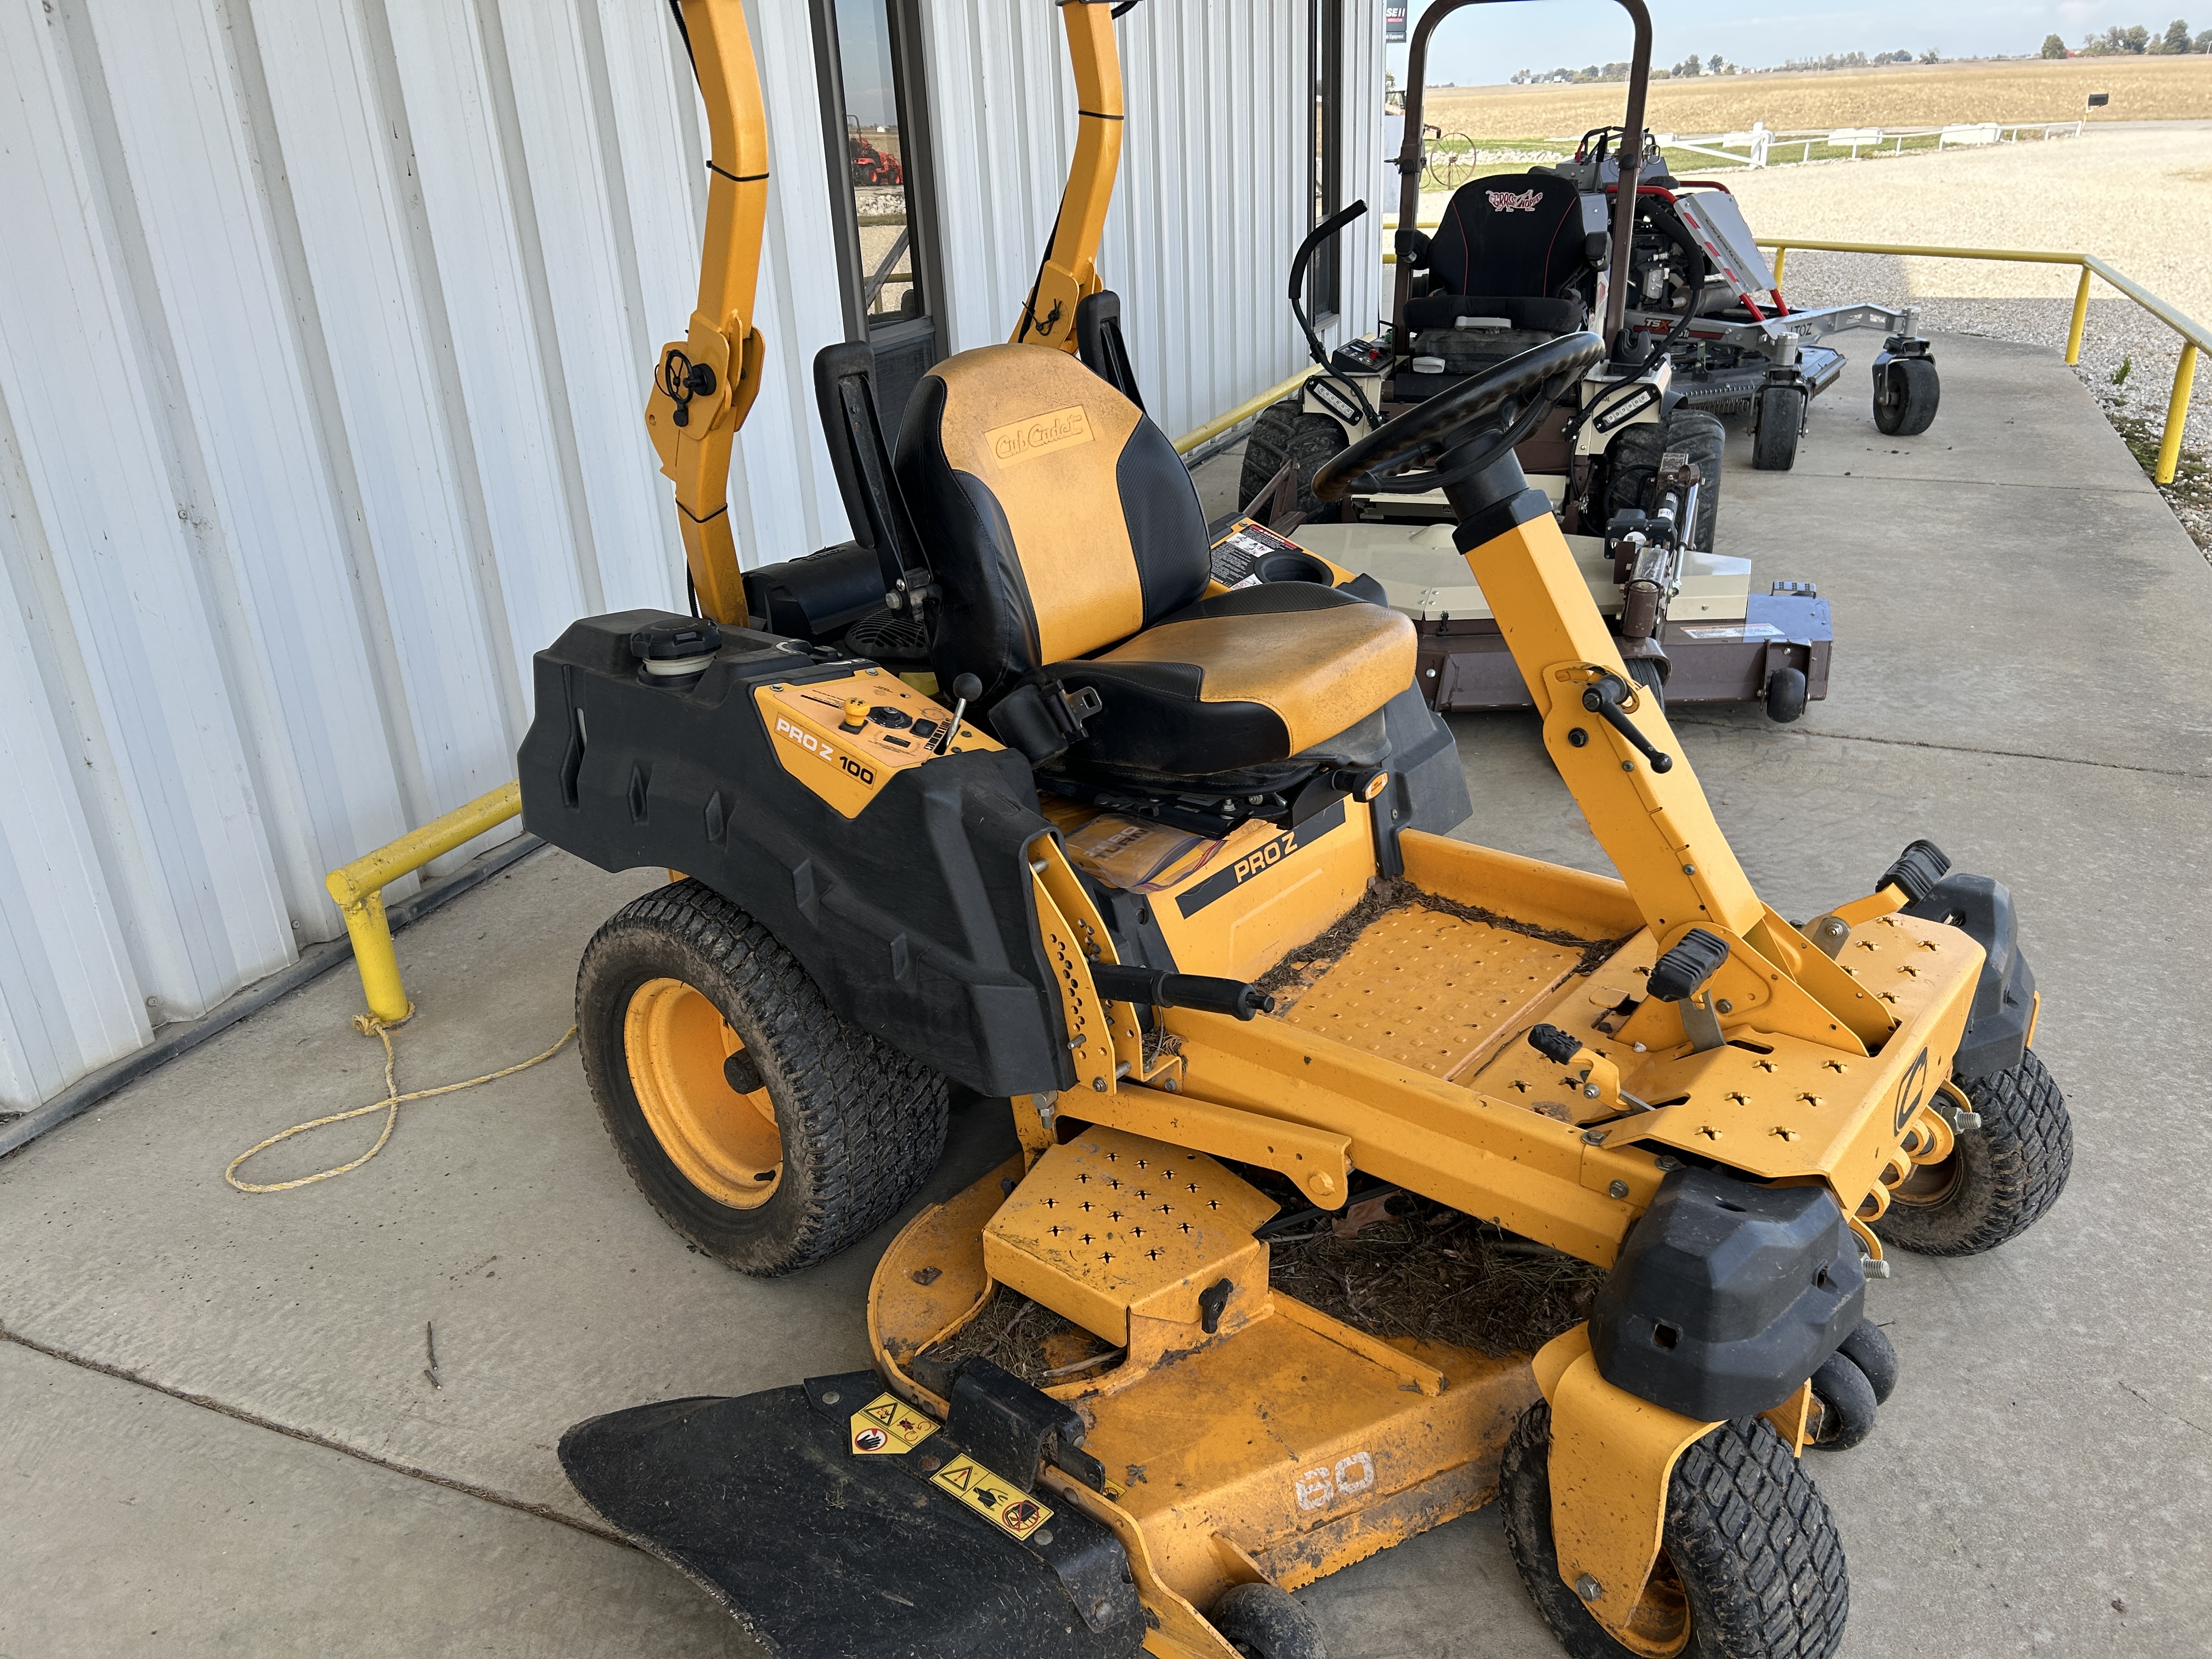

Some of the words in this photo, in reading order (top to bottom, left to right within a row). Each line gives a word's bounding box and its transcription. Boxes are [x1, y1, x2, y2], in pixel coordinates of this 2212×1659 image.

[1646, 319, 1672, 331] TSX
[996, 431, 1028, 459] Cub
[1028, 414, 1082, 448] Cadet
[1263, 531, 1285, 543] DANGER
[776, 718, 817, 752] PRO
[819, 743, 834, 761] Z
[839, 755, 874, 785] 100
[1233, 842, 1280, 883] PRO
[1283, 831, 1298, 855] Z
[1295, 1452, 1374, 1511] 60
